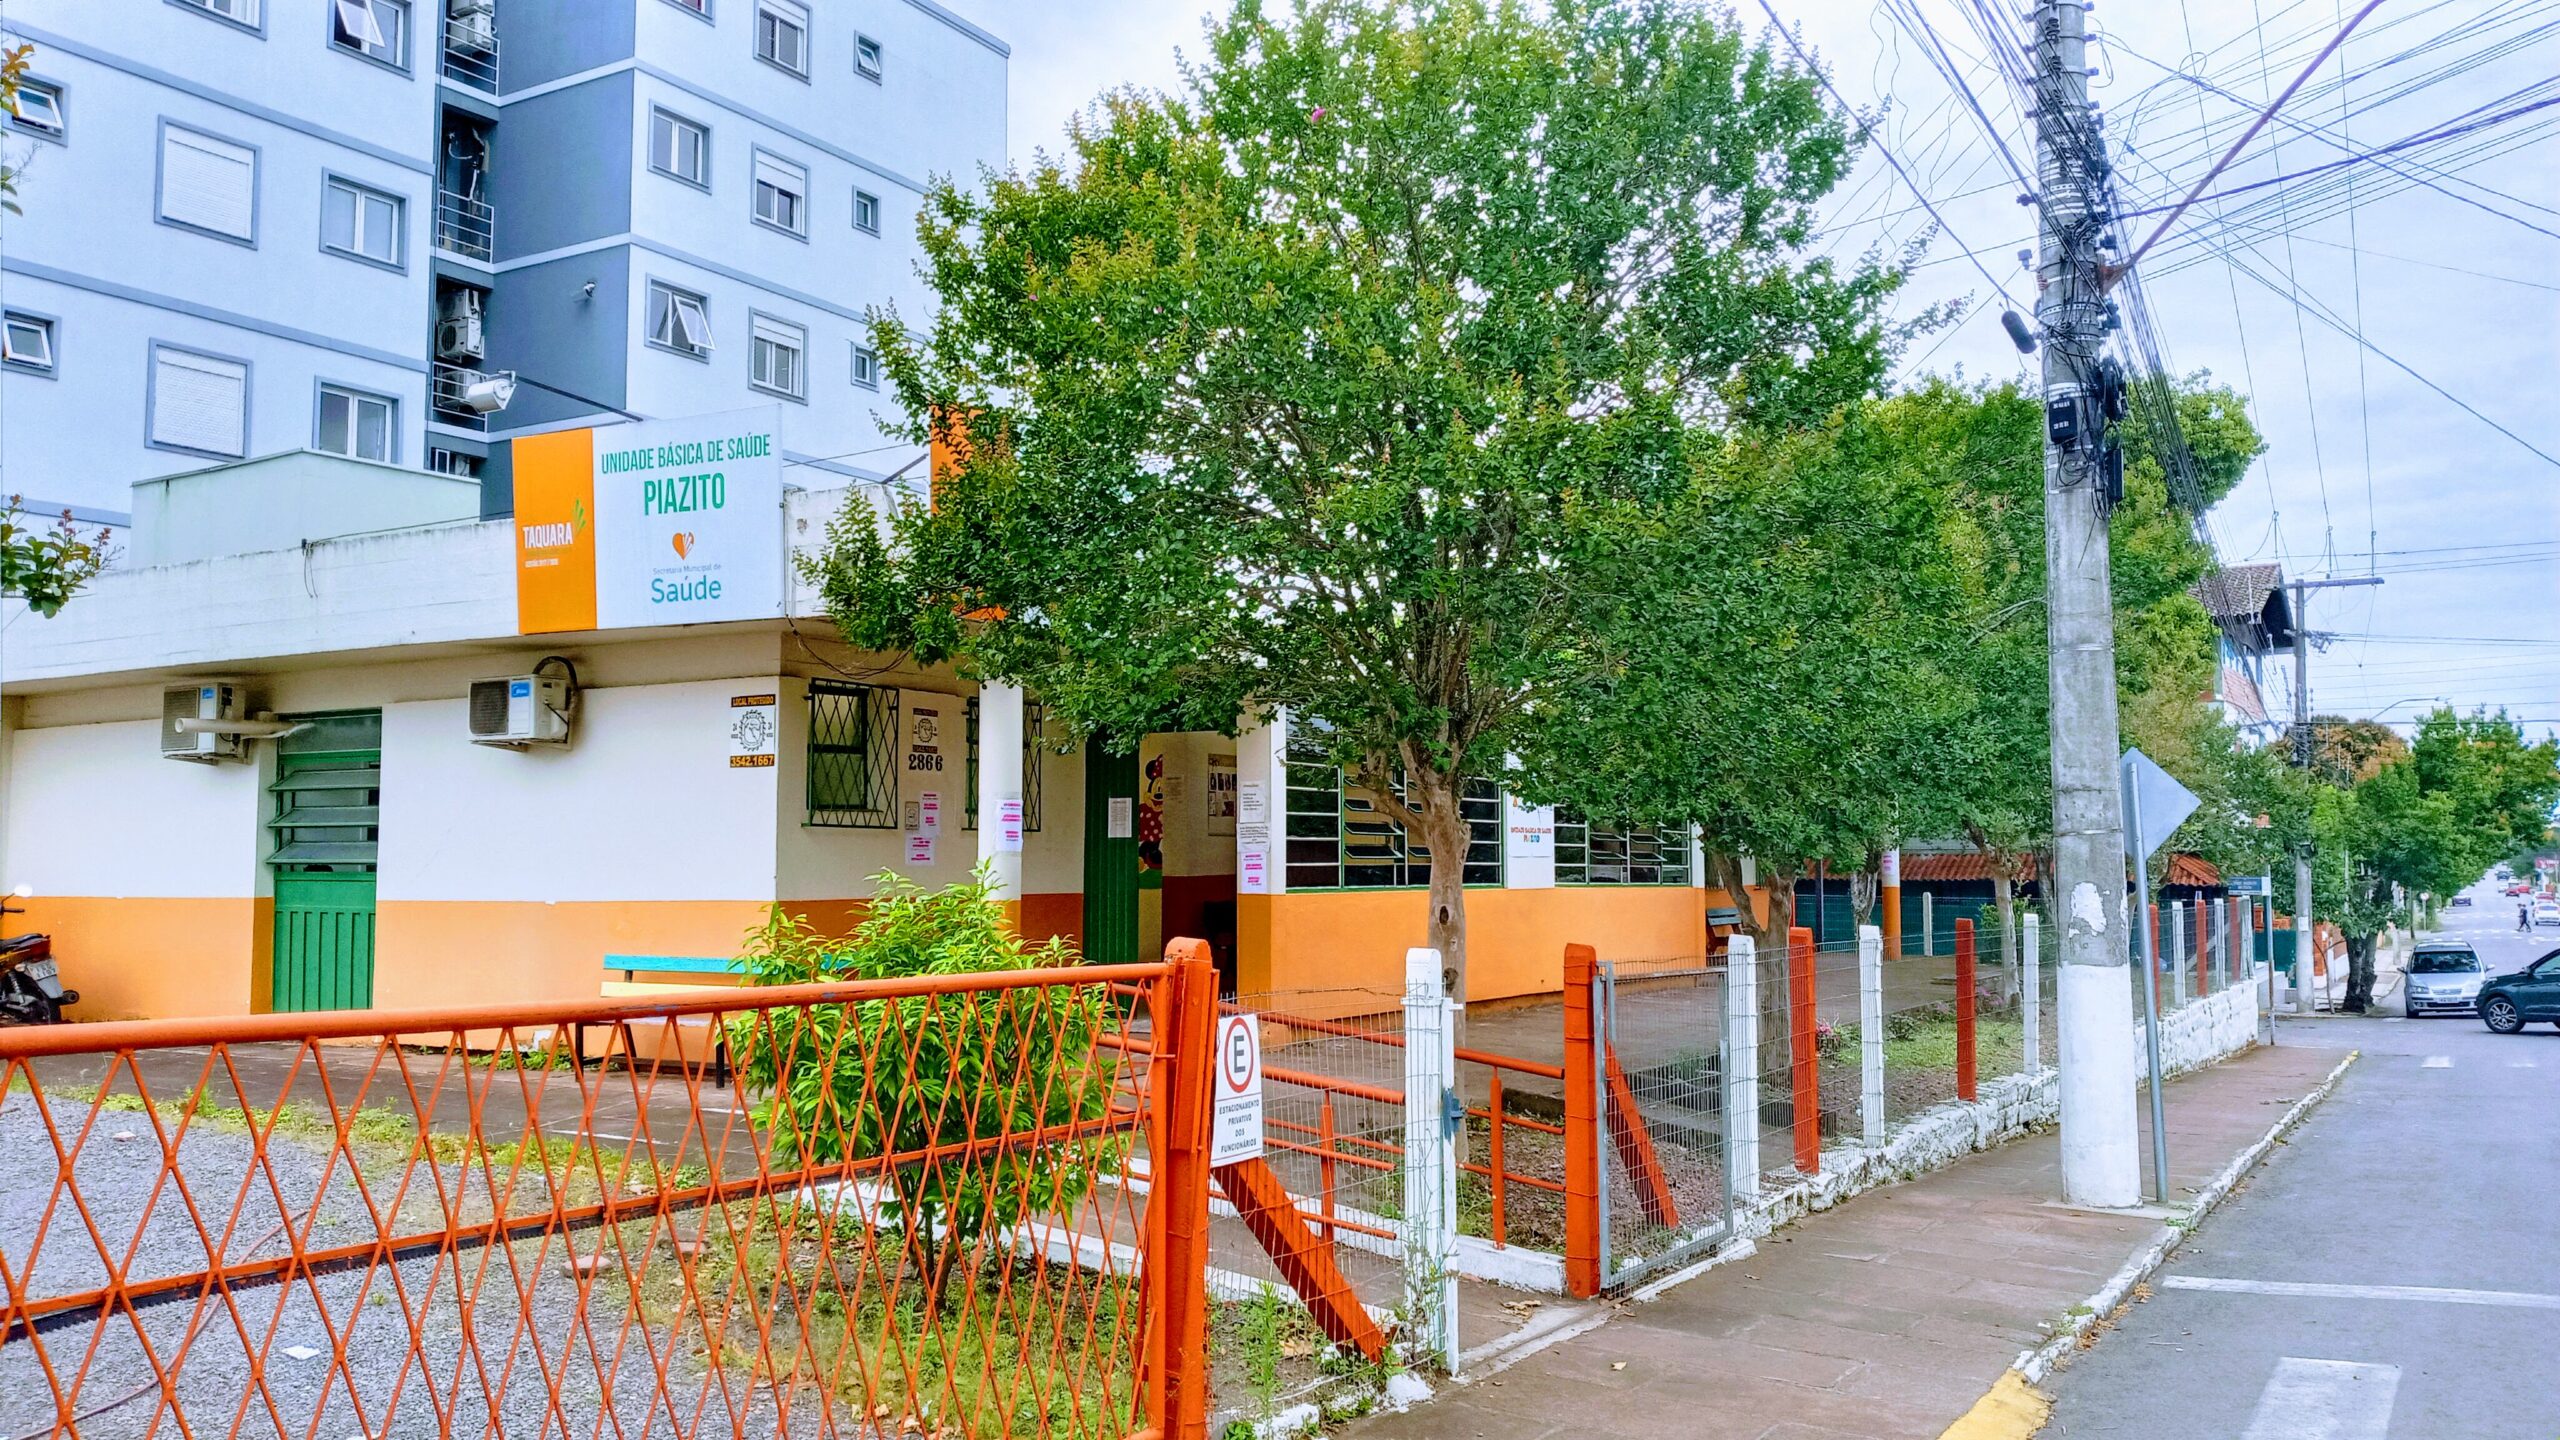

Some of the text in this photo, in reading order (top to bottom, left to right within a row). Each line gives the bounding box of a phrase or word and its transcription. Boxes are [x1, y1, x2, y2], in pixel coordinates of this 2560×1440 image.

[601, 432, 771, 475] UNIDADE BÁSICA DE SAÚDE
[644, 472, 725, 516] PIAZITO
[522, 522, 573, 549] TAQUARA
[651, 574, 722, 603] Saúde
[908, 753, 944, 771] 2866
[1233, 1035, 1246, 1073] E
[1219, 1099, 1260, 1115] ESTACIONAMENTO
[1228, 1113, 1252, 1126] PRIVATIVO
[1235, 1128, 1245, 1137] DOS
[1221, 1138, 1257, 1153] FUNCIONÁRIOS
